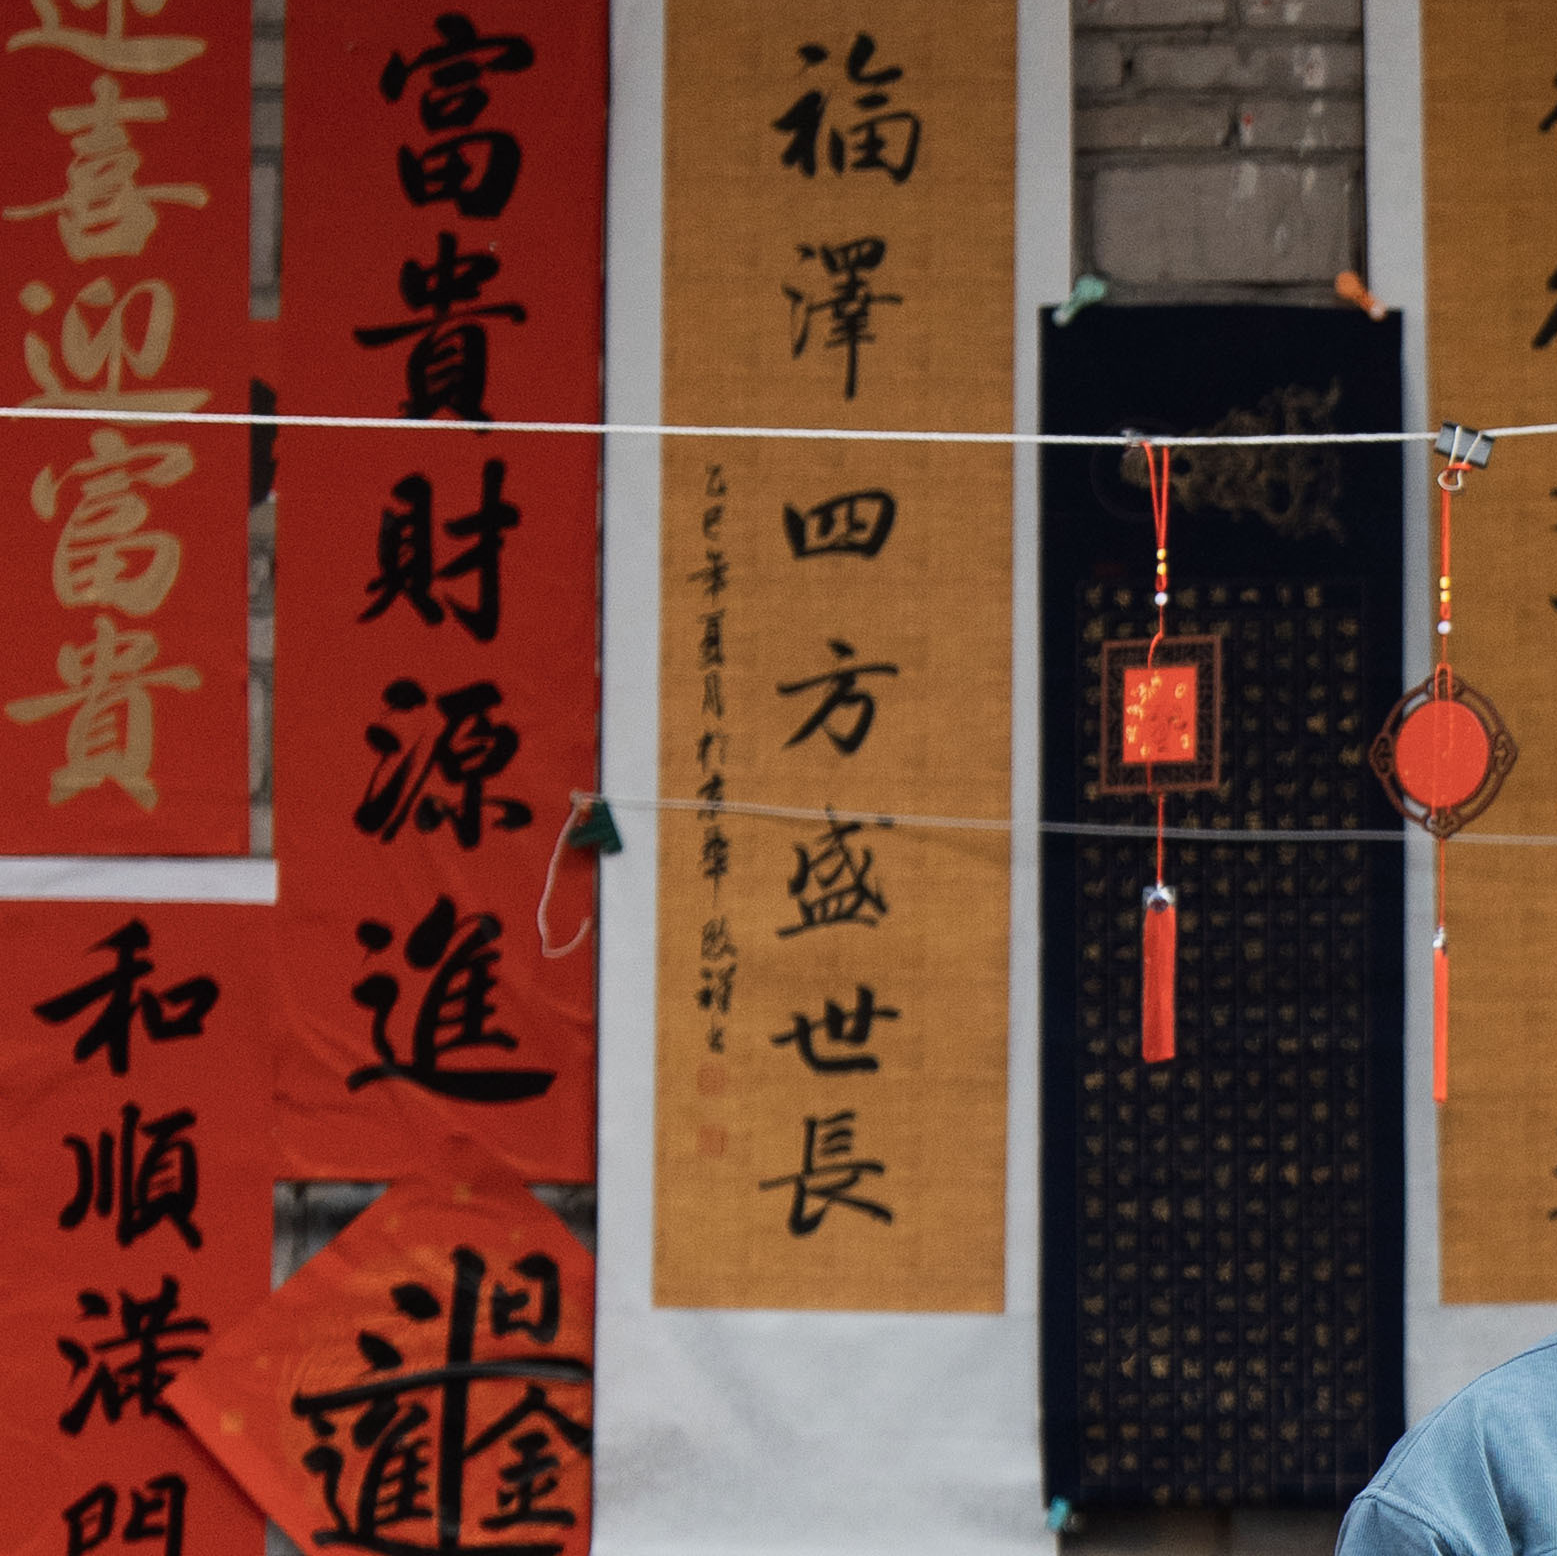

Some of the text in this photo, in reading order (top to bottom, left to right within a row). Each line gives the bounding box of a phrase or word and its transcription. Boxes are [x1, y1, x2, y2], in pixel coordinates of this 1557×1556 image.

[760, 32, 922, 1237] 福澤四方盛世長
